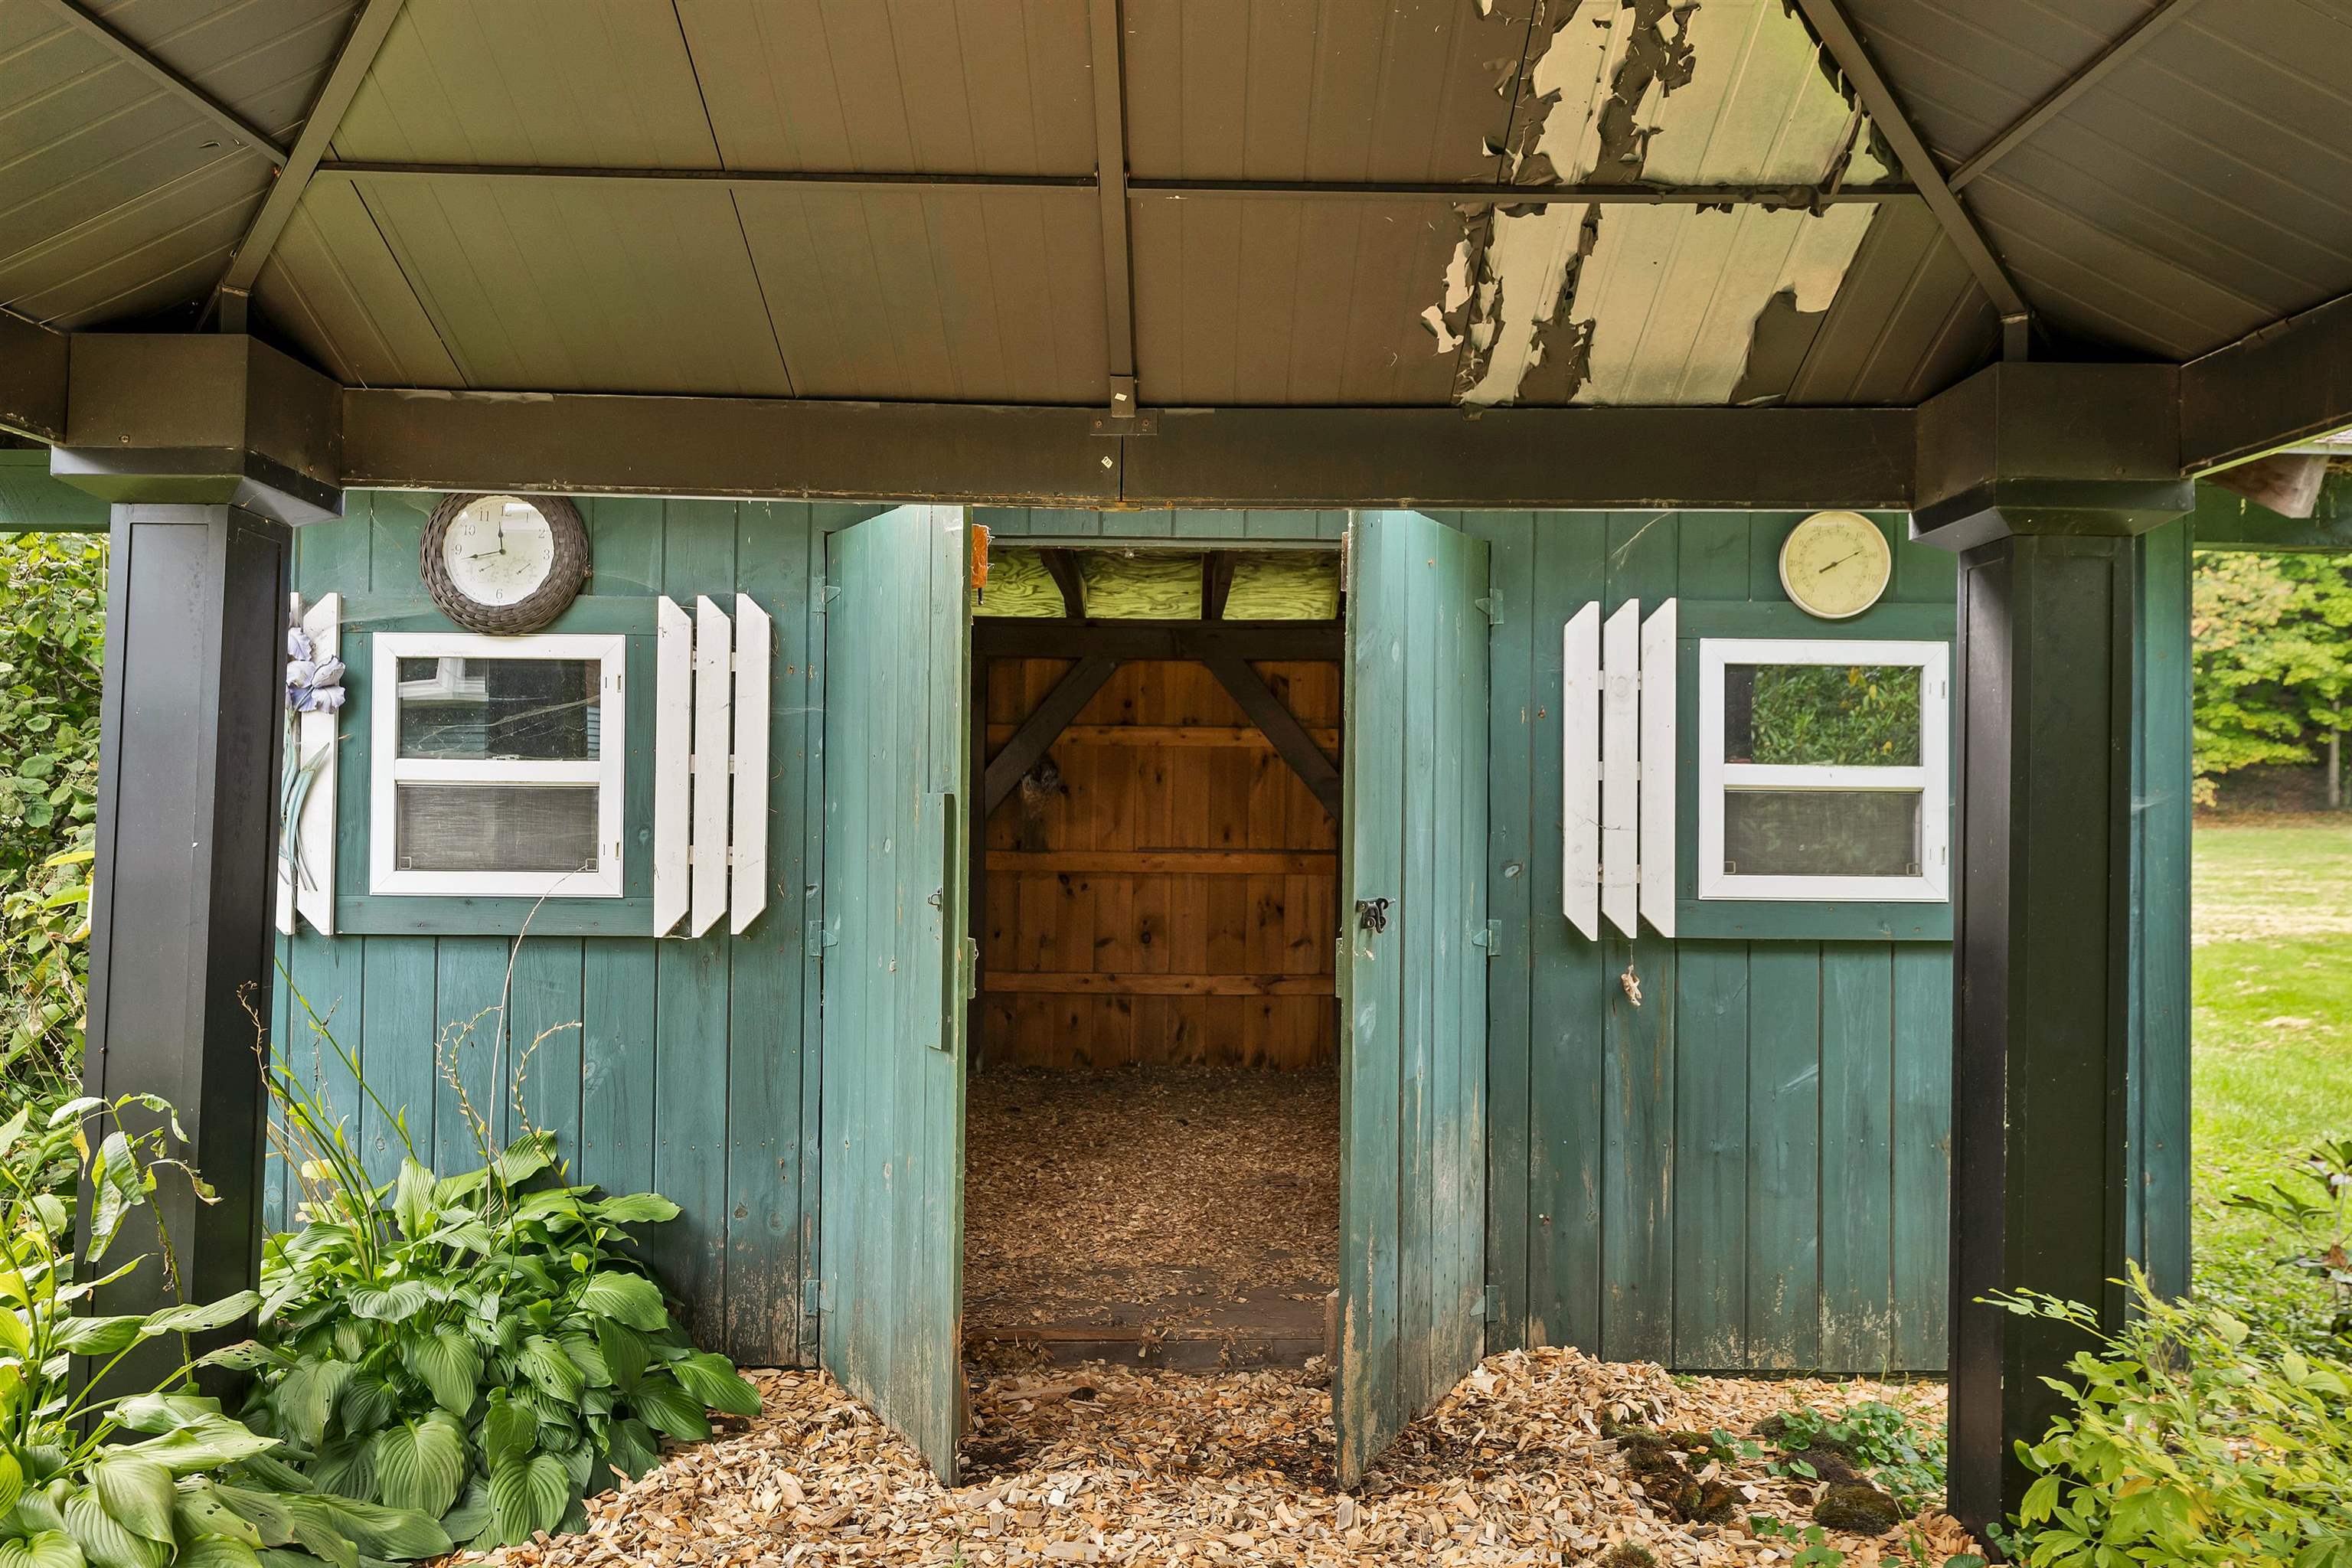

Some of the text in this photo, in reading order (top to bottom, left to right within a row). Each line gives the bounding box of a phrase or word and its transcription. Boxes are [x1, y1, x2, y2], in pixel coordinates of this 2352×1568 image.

[479, 510, 490, 521] 11
[463, 524, 475, 537] 10
[538, 528, 545, 538] 2
[455, 544, 462, 555] 9
[543, 549, 550, 560] 3
[495, 588, 503, 599] 6
